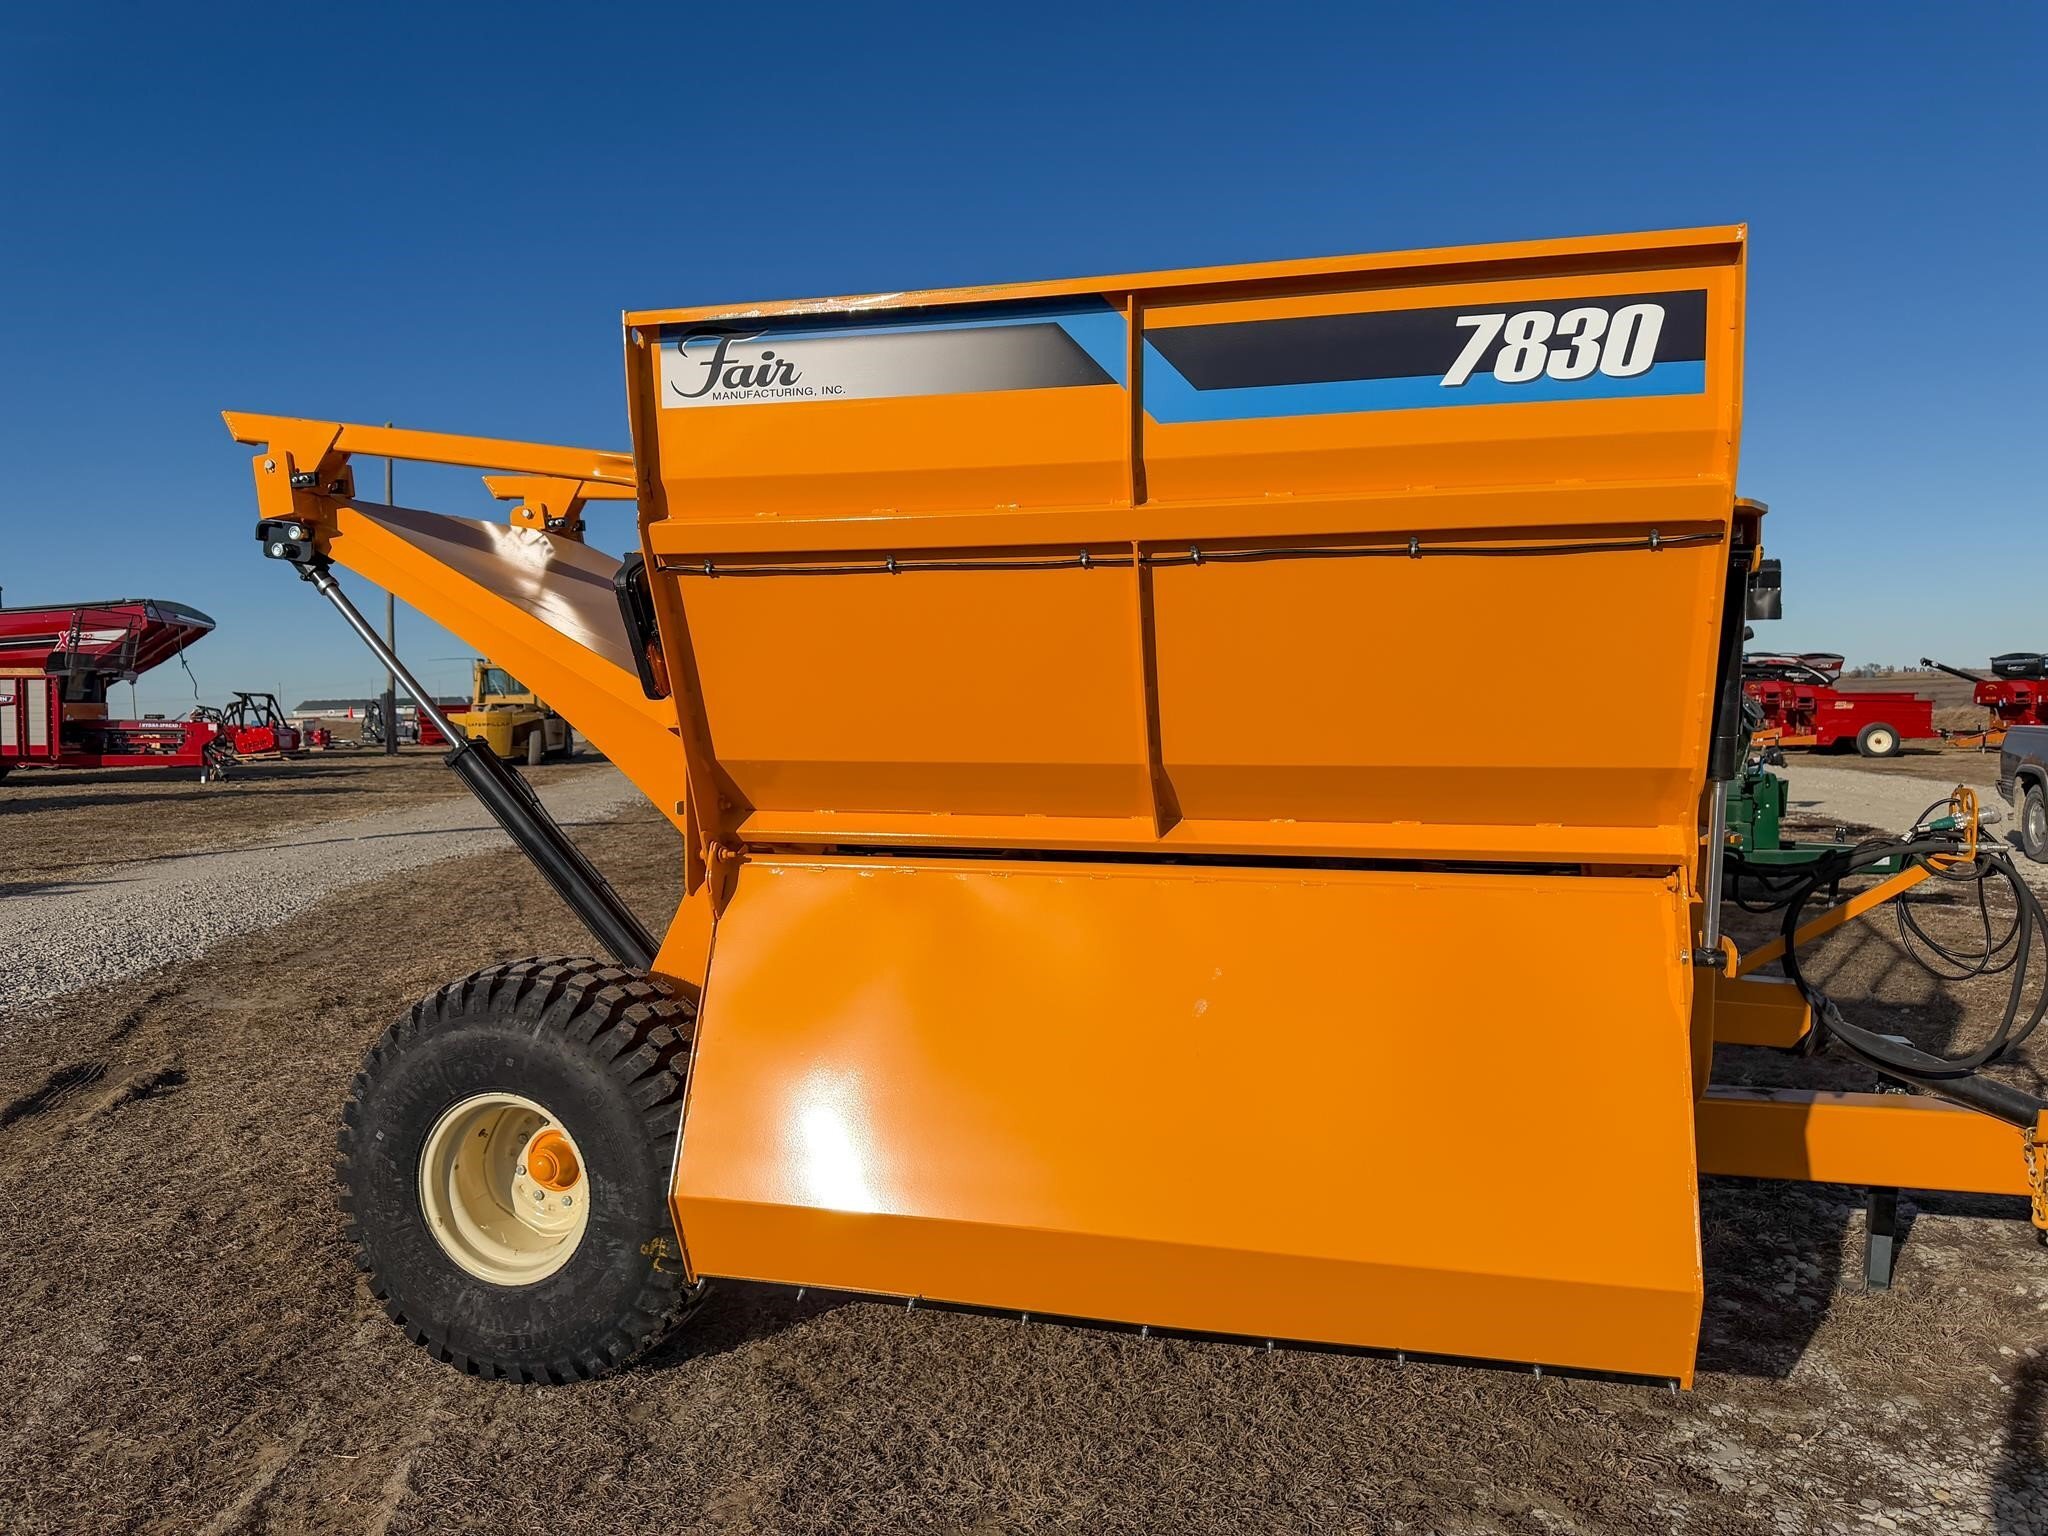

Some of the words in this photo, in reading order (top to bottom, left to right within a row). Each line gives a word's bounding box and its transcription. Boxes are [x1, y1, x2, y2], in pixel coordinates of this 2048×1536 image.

[671, 326, 803, 398] Fair
[1440, 303, 1666, 388] 7830
[713, 386, 817, 401] MANUFACTURING,
[821, 384, 846, 396] INC.
